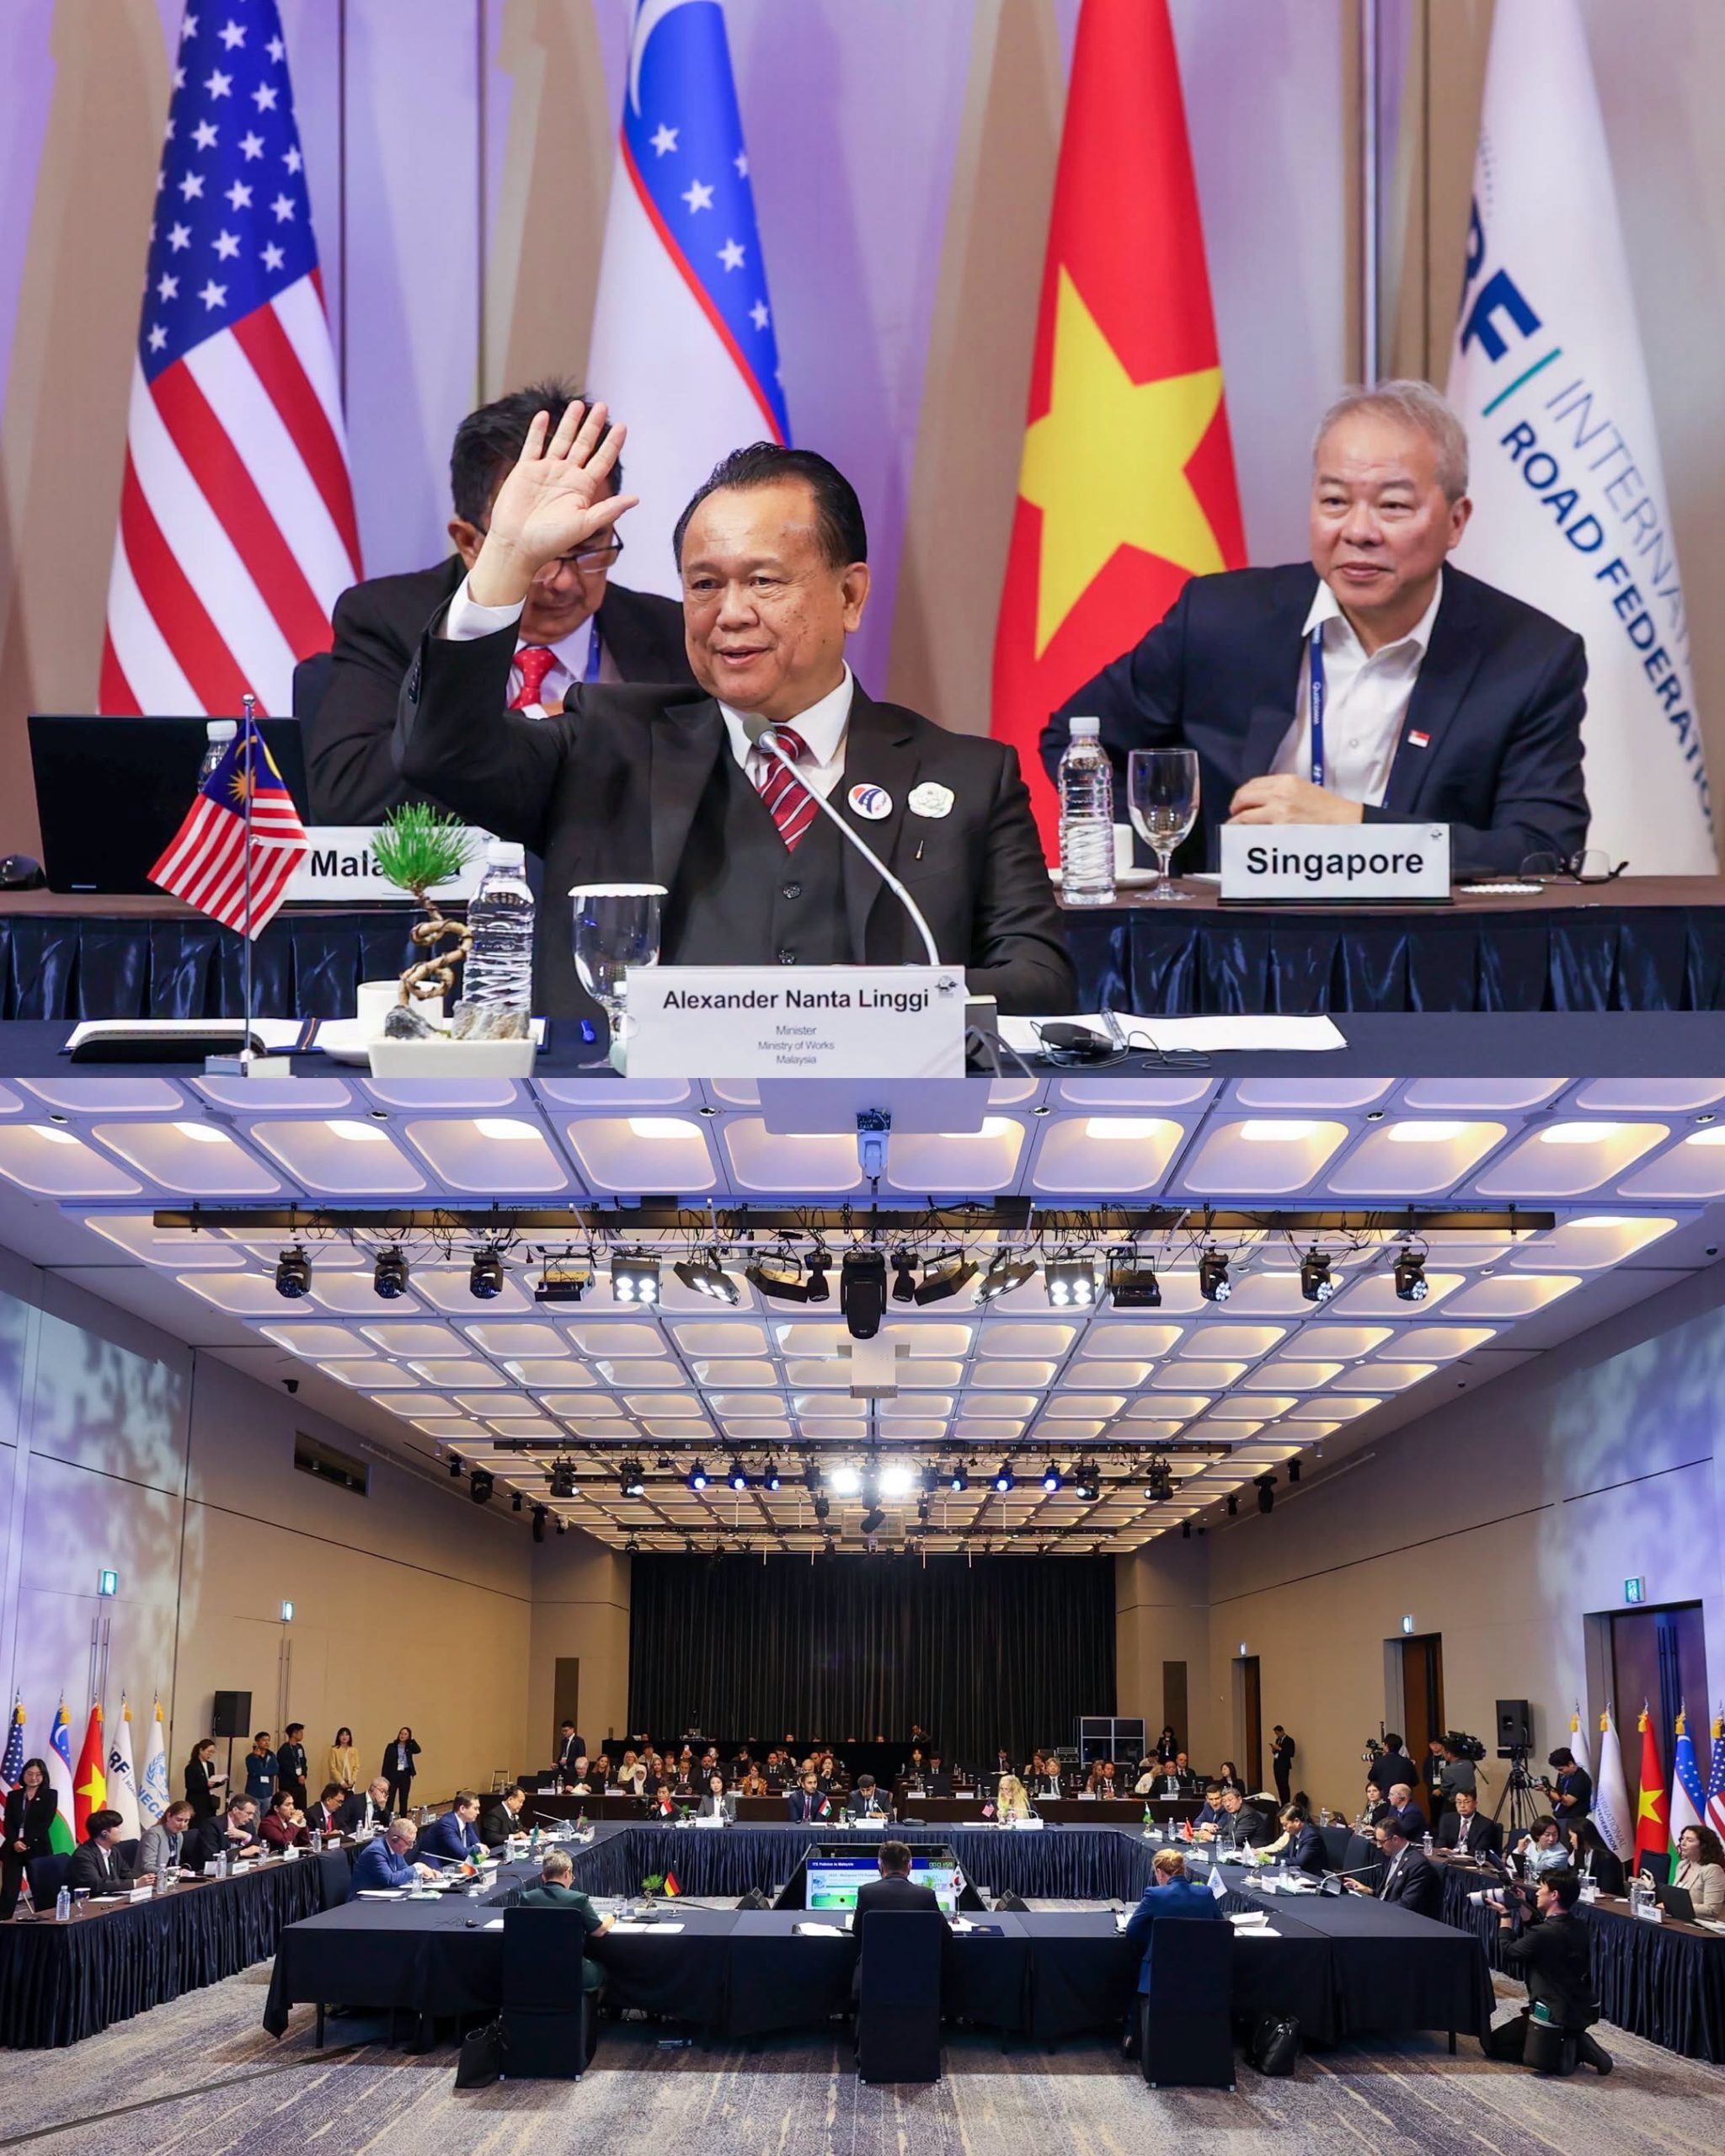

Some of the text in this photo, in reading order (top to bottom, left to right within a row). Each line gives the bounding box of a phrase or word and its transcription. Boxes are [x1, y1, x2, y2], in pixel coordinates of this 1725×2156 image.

[1499, 419, 1604, 554] ROAD
[1247, 846, 1423, 882] Singapore
[664, 989, 929, 1013] Alexander Nanta Linggi
[776, 1025, 817, 1036] Minister
[758, 1040, 836, 1053] Ministry of Works
[776, 1054, 817, 1066] Malaysia
